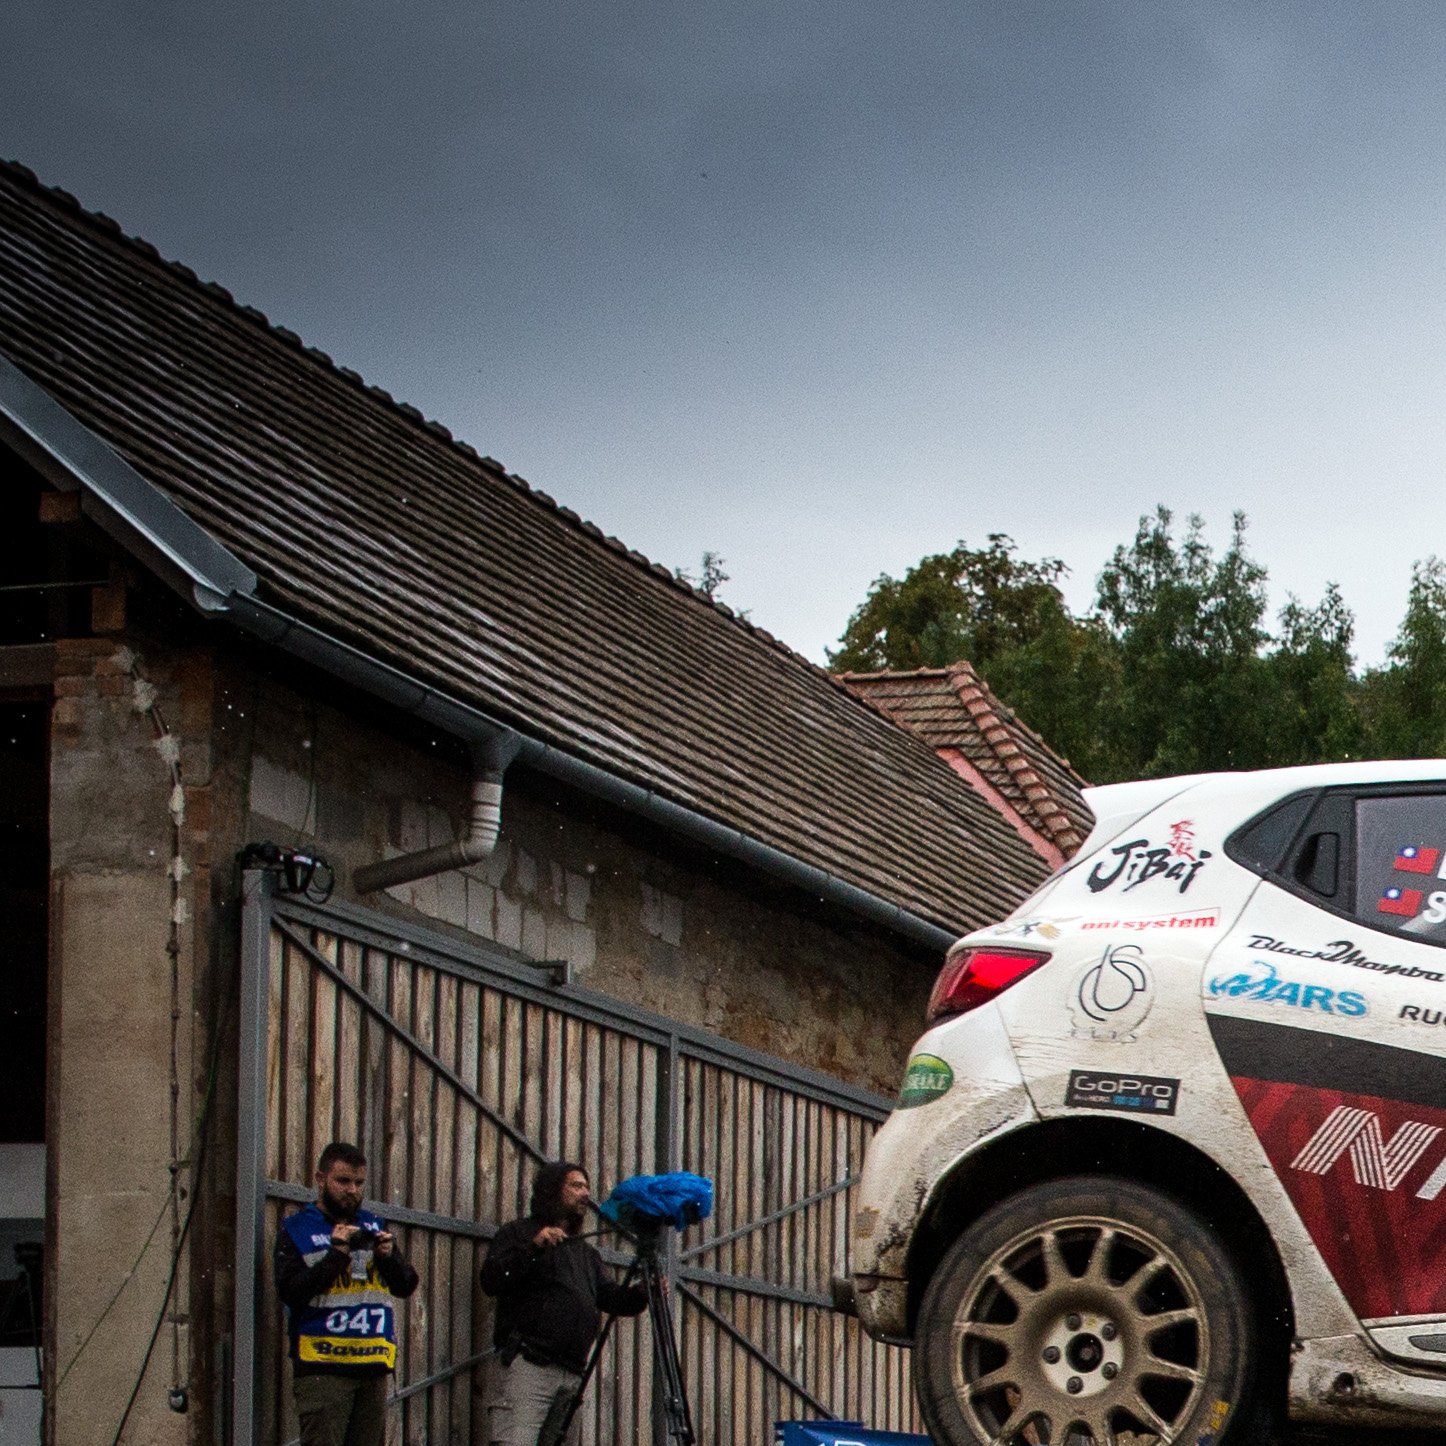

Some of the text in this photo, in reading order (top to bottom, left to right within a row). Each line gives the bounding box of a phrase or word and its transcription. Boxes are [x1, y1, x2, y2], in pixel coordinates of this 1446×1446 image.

[1209, 973, 1367, 1016] MARS
[1074, 1075, 1172, 1097] GoPro
[326, 1308, 386, 1334] 047
[312, 1340, 389, 1357] Barum
